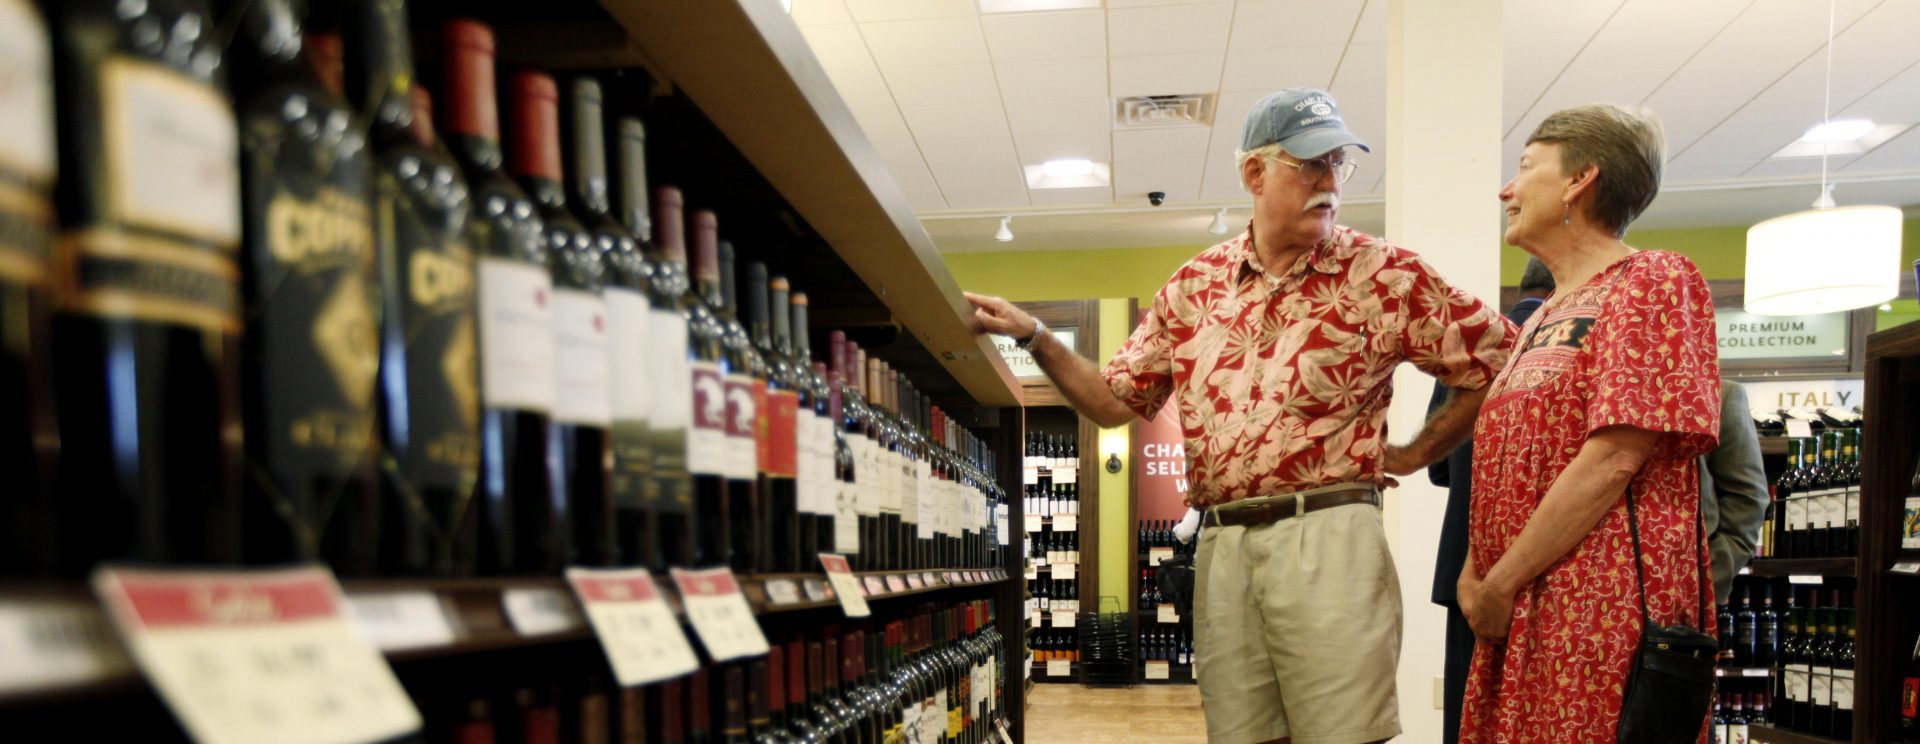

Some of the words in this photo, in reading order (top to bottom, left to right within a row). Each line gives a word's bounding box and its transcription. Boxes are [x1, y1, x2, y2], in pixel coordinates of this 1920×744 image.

[1729, 322, 1805, 333] PREMIUM
[1718, 335, 1816, 348] COLLECTION
[1777, 391, 1852, 408] ITALY
